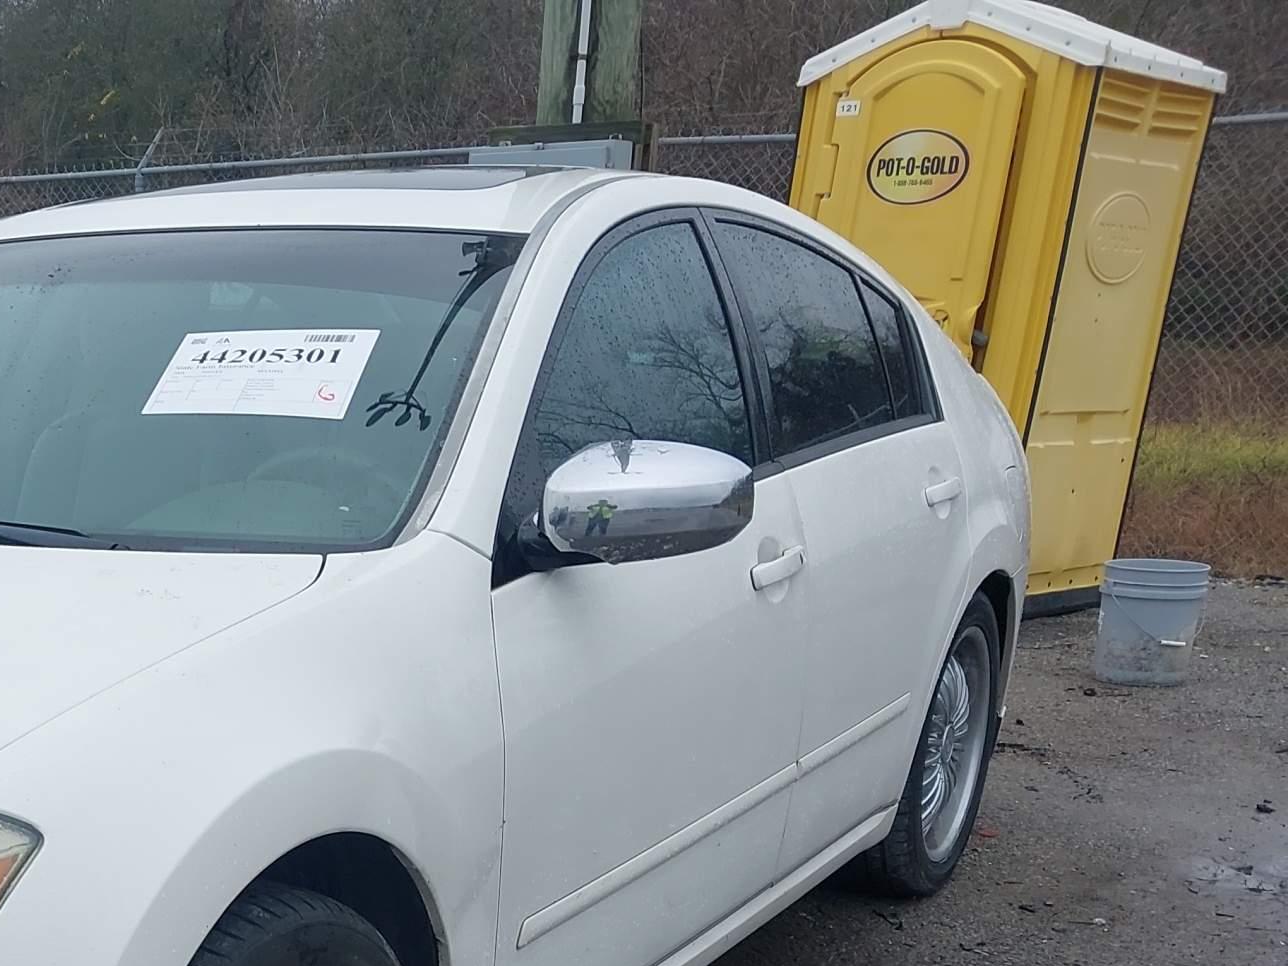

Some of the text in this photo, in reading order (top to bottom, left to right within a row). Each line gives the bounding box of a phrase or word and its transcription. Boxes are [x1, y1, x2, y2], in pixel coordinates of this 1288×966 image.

[840, 104, 857, 113] 121
[876, 155, 960, 178] POT-O-GOLD
[191, 347, 342, 364] 44205301
